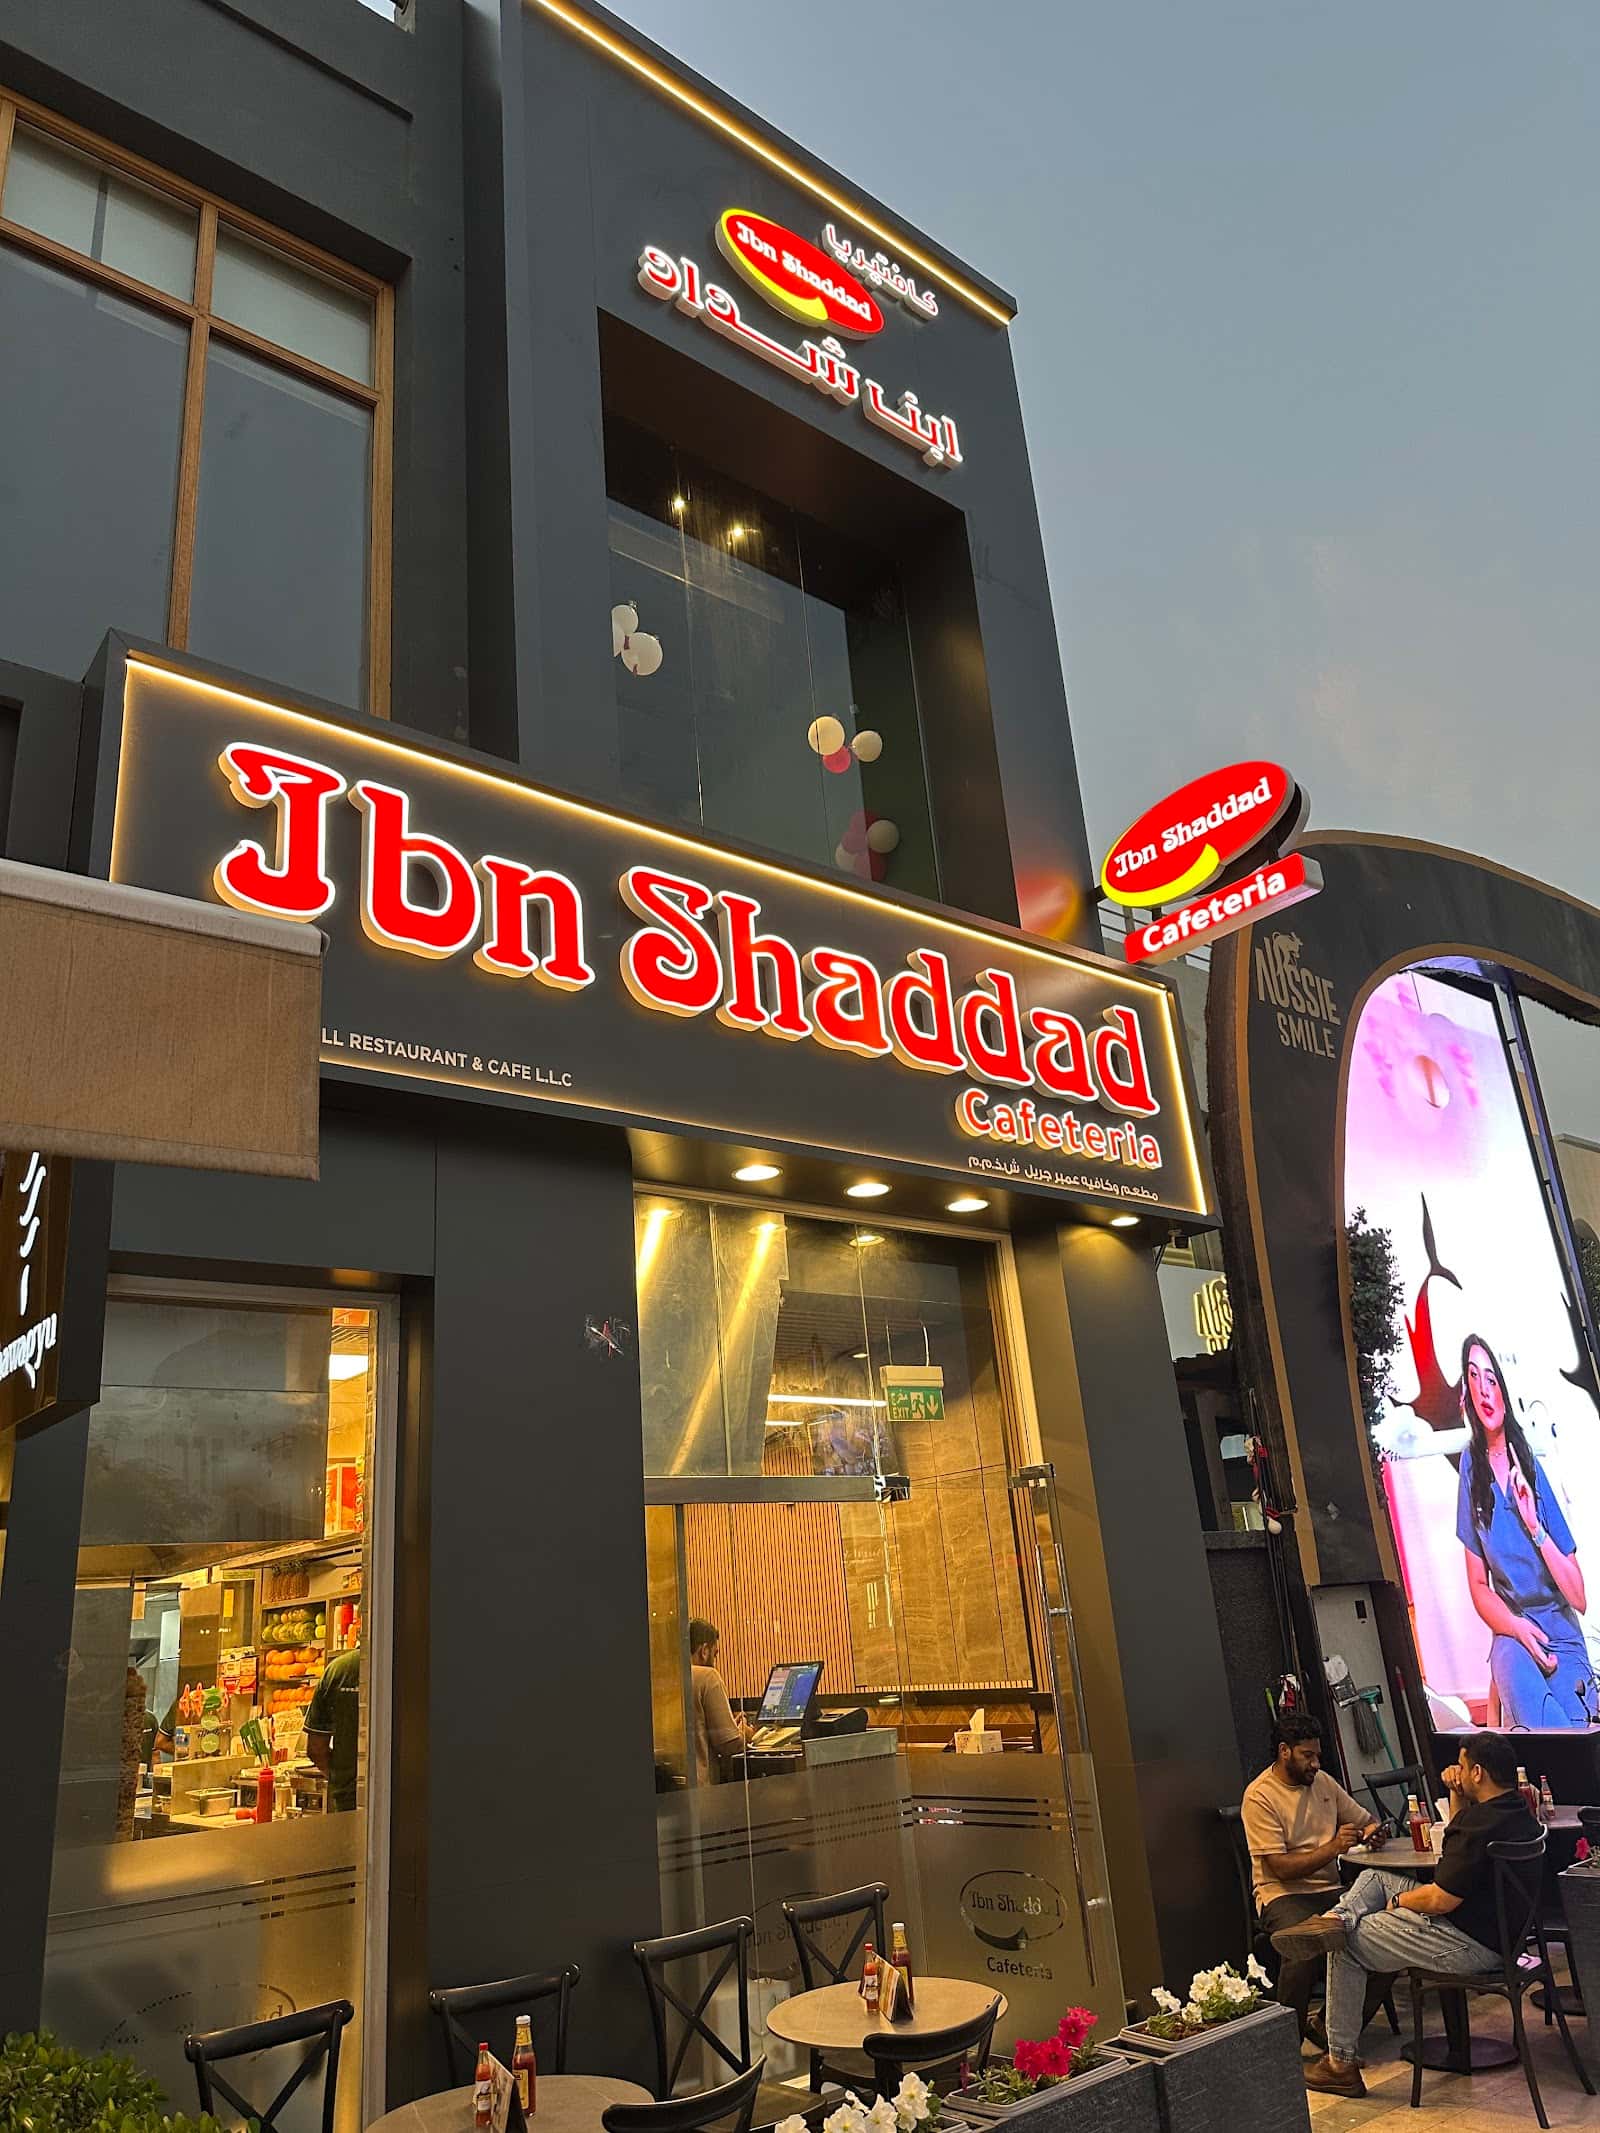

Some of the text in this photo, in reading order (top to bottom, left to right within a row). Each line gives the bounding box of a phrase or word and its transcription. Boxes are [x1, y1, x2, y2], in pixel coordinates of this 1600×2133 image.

[781, 249, 872, 321] Shaddad
[822, 223, 939, 317] كافتيريا
[1160, 776, 1273, 853] Shaddad
[1141, 870, 1287, 953] Cafeteria
[622, 865, 1161, 1118] Shaddad
[321, 1027, 573, 1088] LL RESTAURANT & CAFE L.L.C
[1277, 1011, 1337, 1058] SMILE
[957, 1087, 1163, 1169] Cafeteria
[1120, 1185, 1159, 1201] مطعم
[892, 1406, 911, 1420] EXIT
